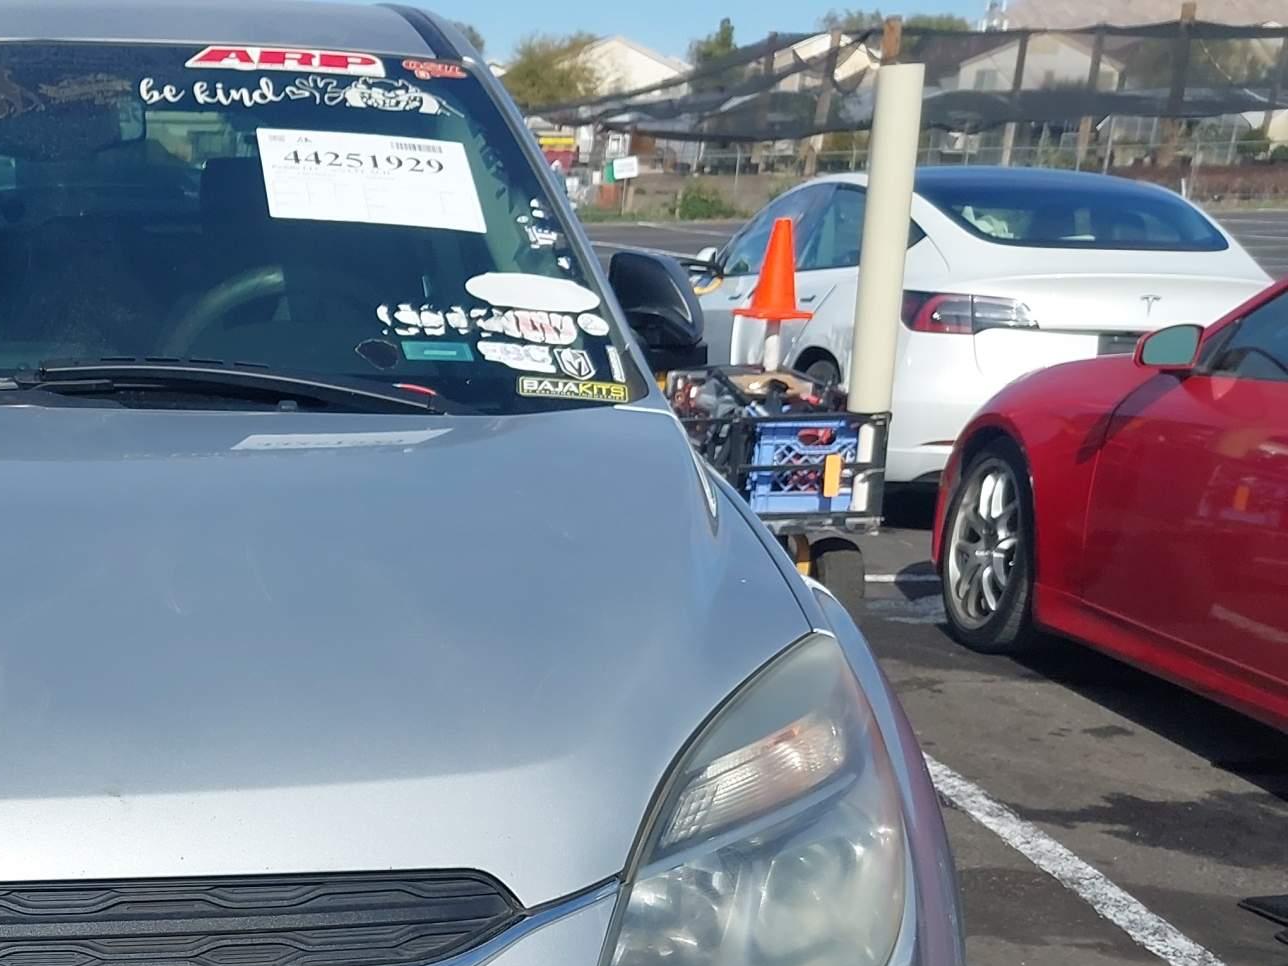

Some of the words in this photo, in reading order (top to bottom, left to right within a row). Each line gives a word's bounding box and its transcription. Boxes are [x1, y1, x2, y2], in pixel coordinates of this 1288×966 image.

[194, 48, 378, 70] ARP
[139, 77, 185, 104] be
[193, 77, 285, 107] kind
[283, 149, 445, 174] 44251929
